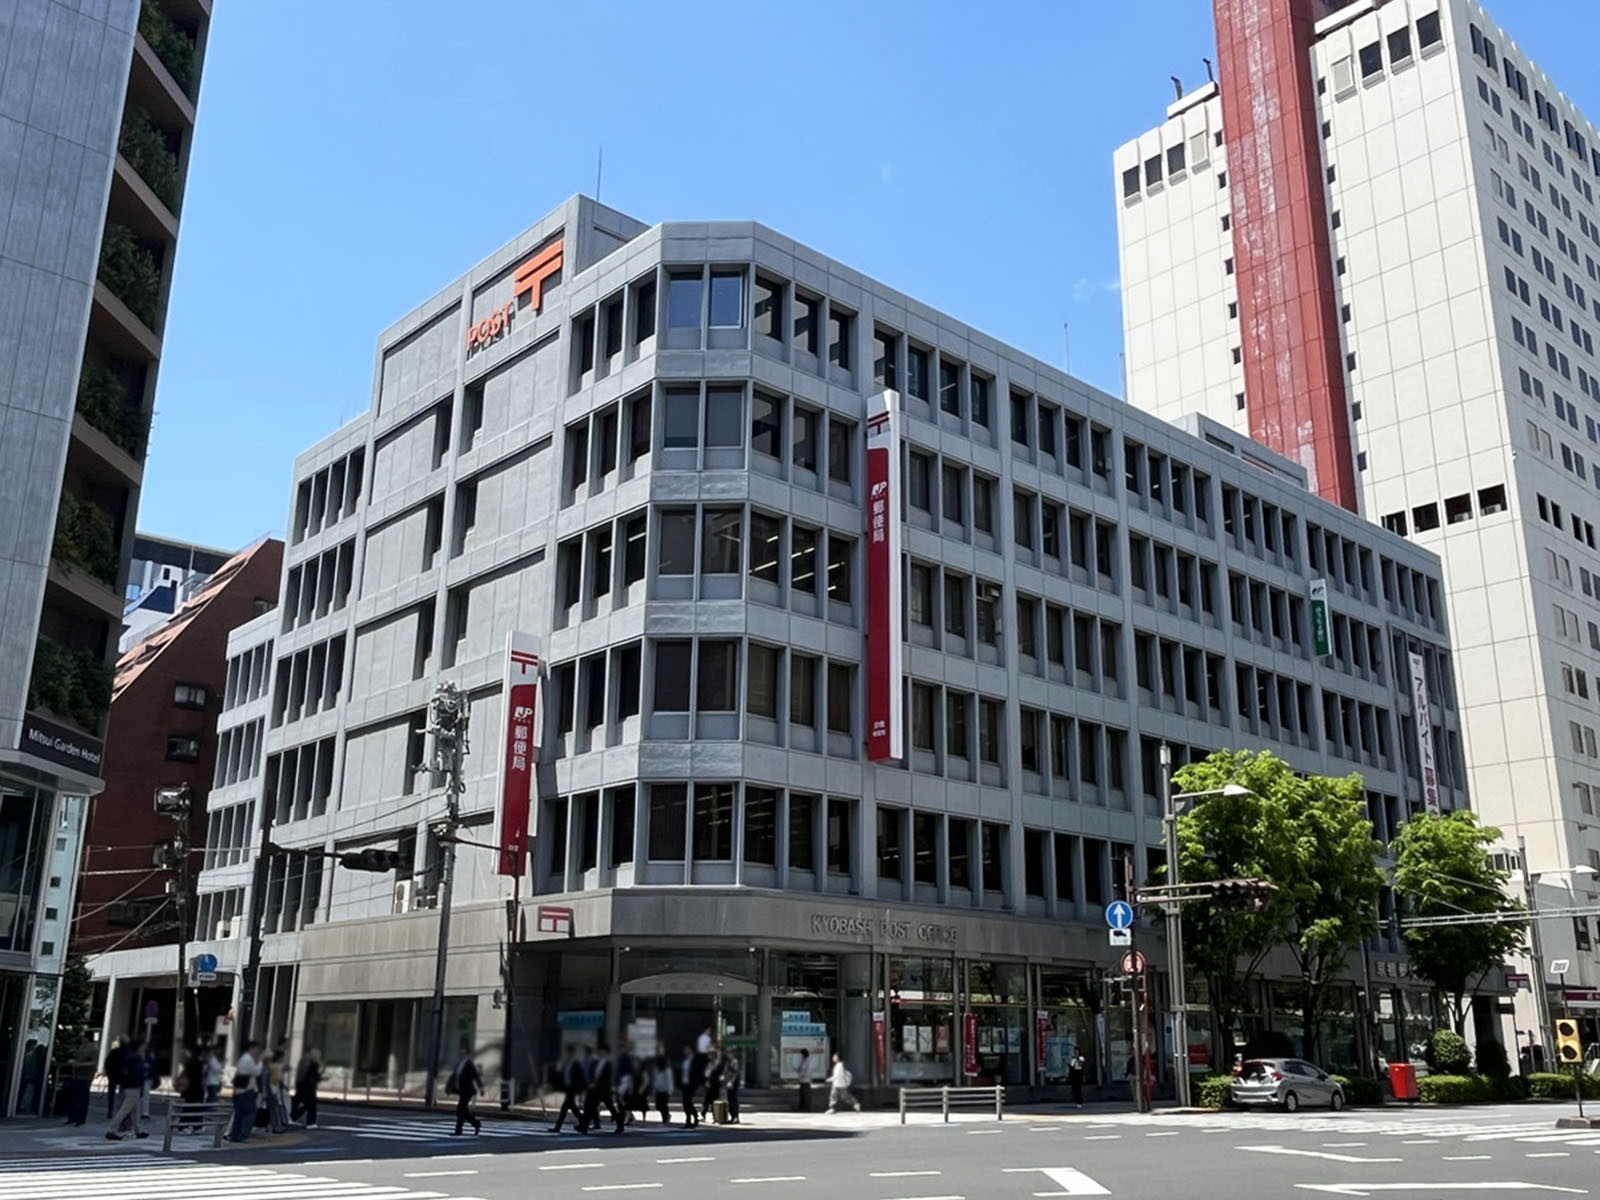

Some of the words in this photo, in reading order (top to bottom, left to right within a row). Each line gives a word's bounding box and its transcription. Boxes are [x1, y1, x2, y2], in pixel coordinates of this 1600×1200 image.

[466, 301, 514, 351] POST
[872, 499, 885, 543] 郵便局
[28, 728, 53, 747] Mitsui
[54, 737, 80, 757] Garden
[81, 748, 101, 764] Hotel
[512, 725, 529, 771] 郵便局
[881, 919, 912, 938] POST
